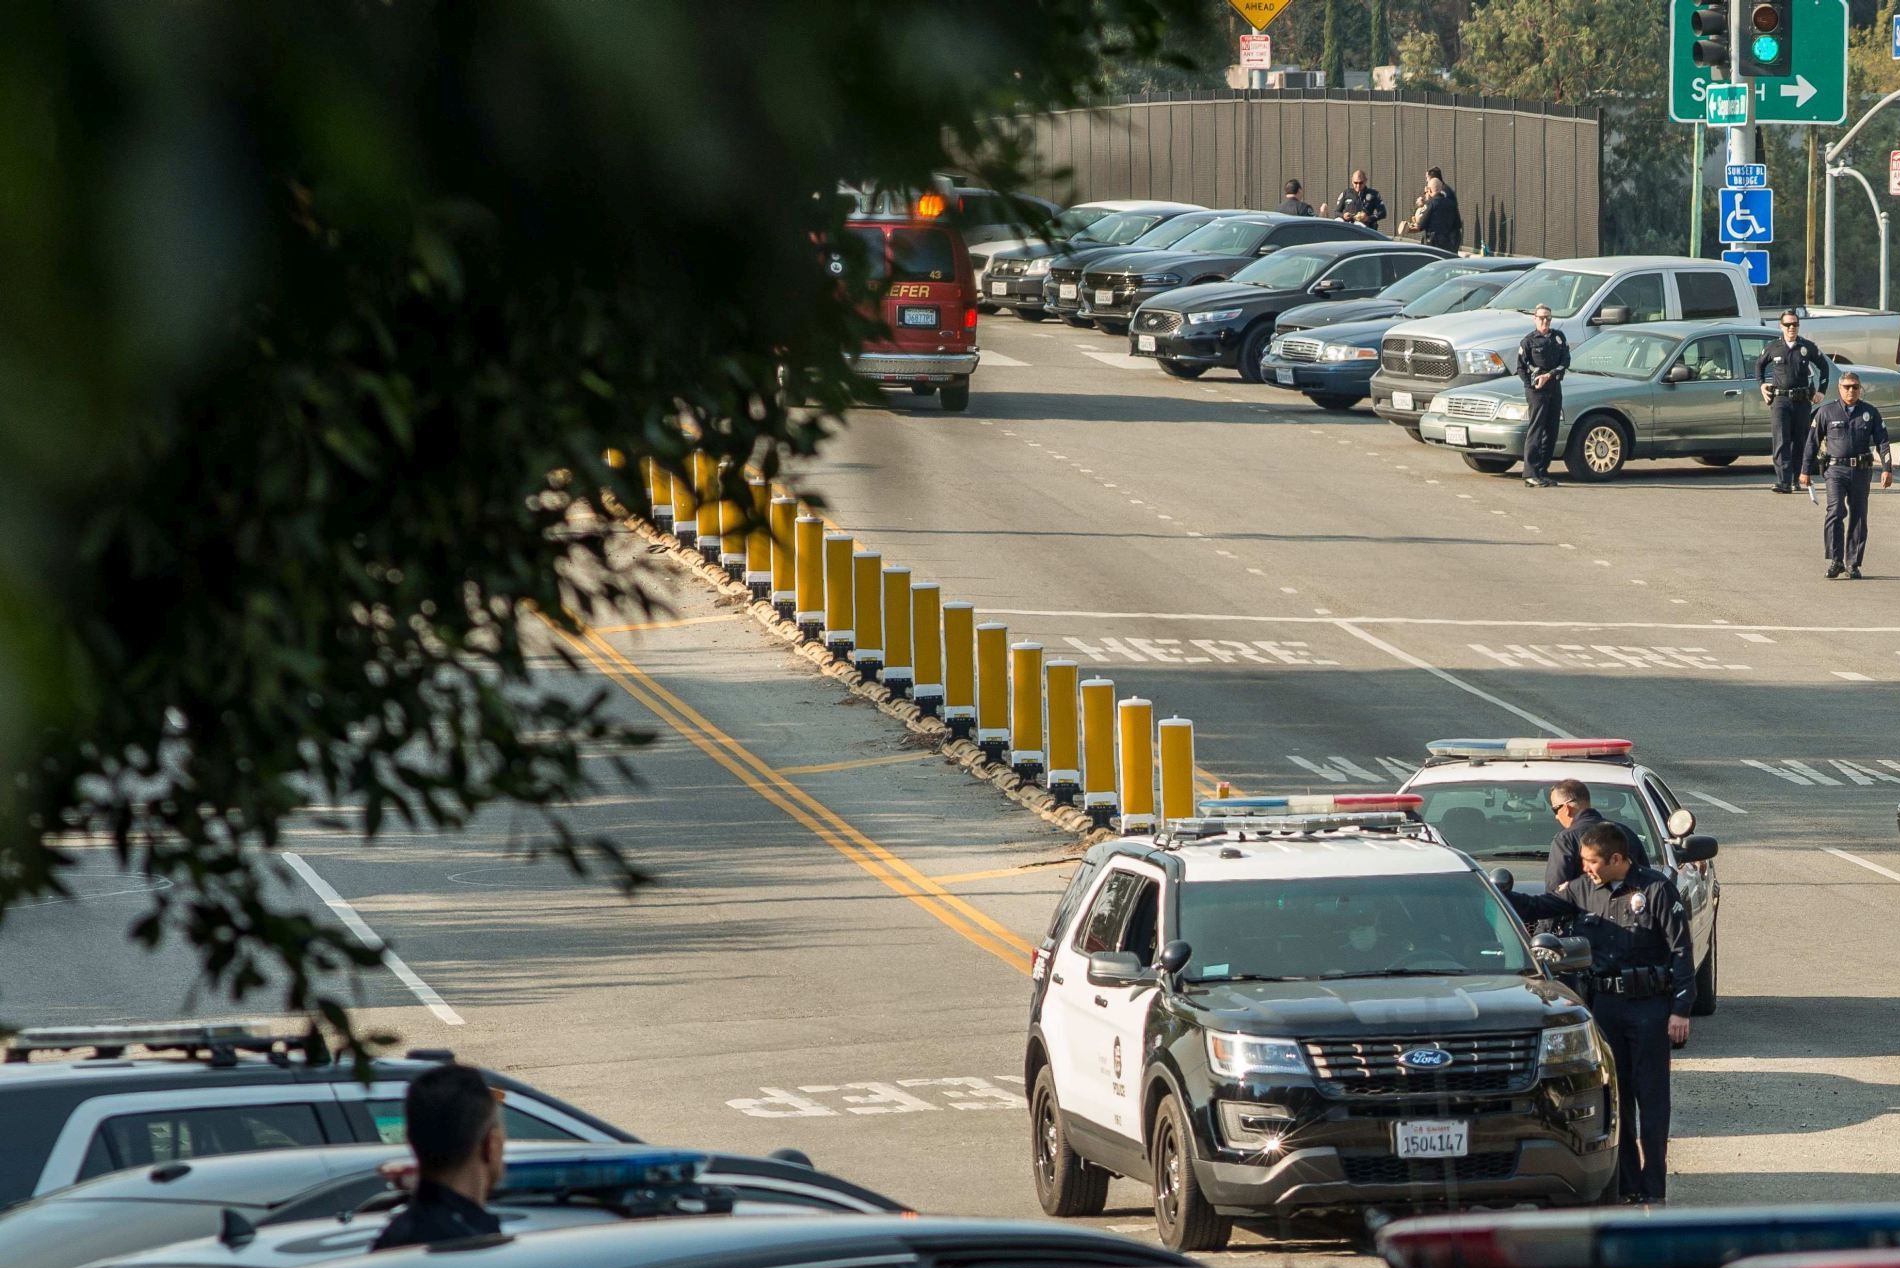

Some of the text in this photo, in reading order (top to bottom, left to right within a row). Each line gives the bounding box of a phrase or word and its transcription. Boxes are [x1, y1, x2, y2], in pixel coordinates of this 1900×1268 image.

[1245, 3, 1275, 11] AHEAD
[1727, 167, 1764, 176] SUNSET BL
[1734, 176, 1758, 185] BRIDGE
[929, 270, 942, 279] 43
[886, 285, 930, 298] EFER
[1063, 637, 1341, 665] HERE
[1468, 644, 1753, 670] HERE
[1412, 1050, 1441, 1064] Ford
[725, 1075, 1026, 1118] EEP
[1404, 1133, 1463, 1153] 1504147
